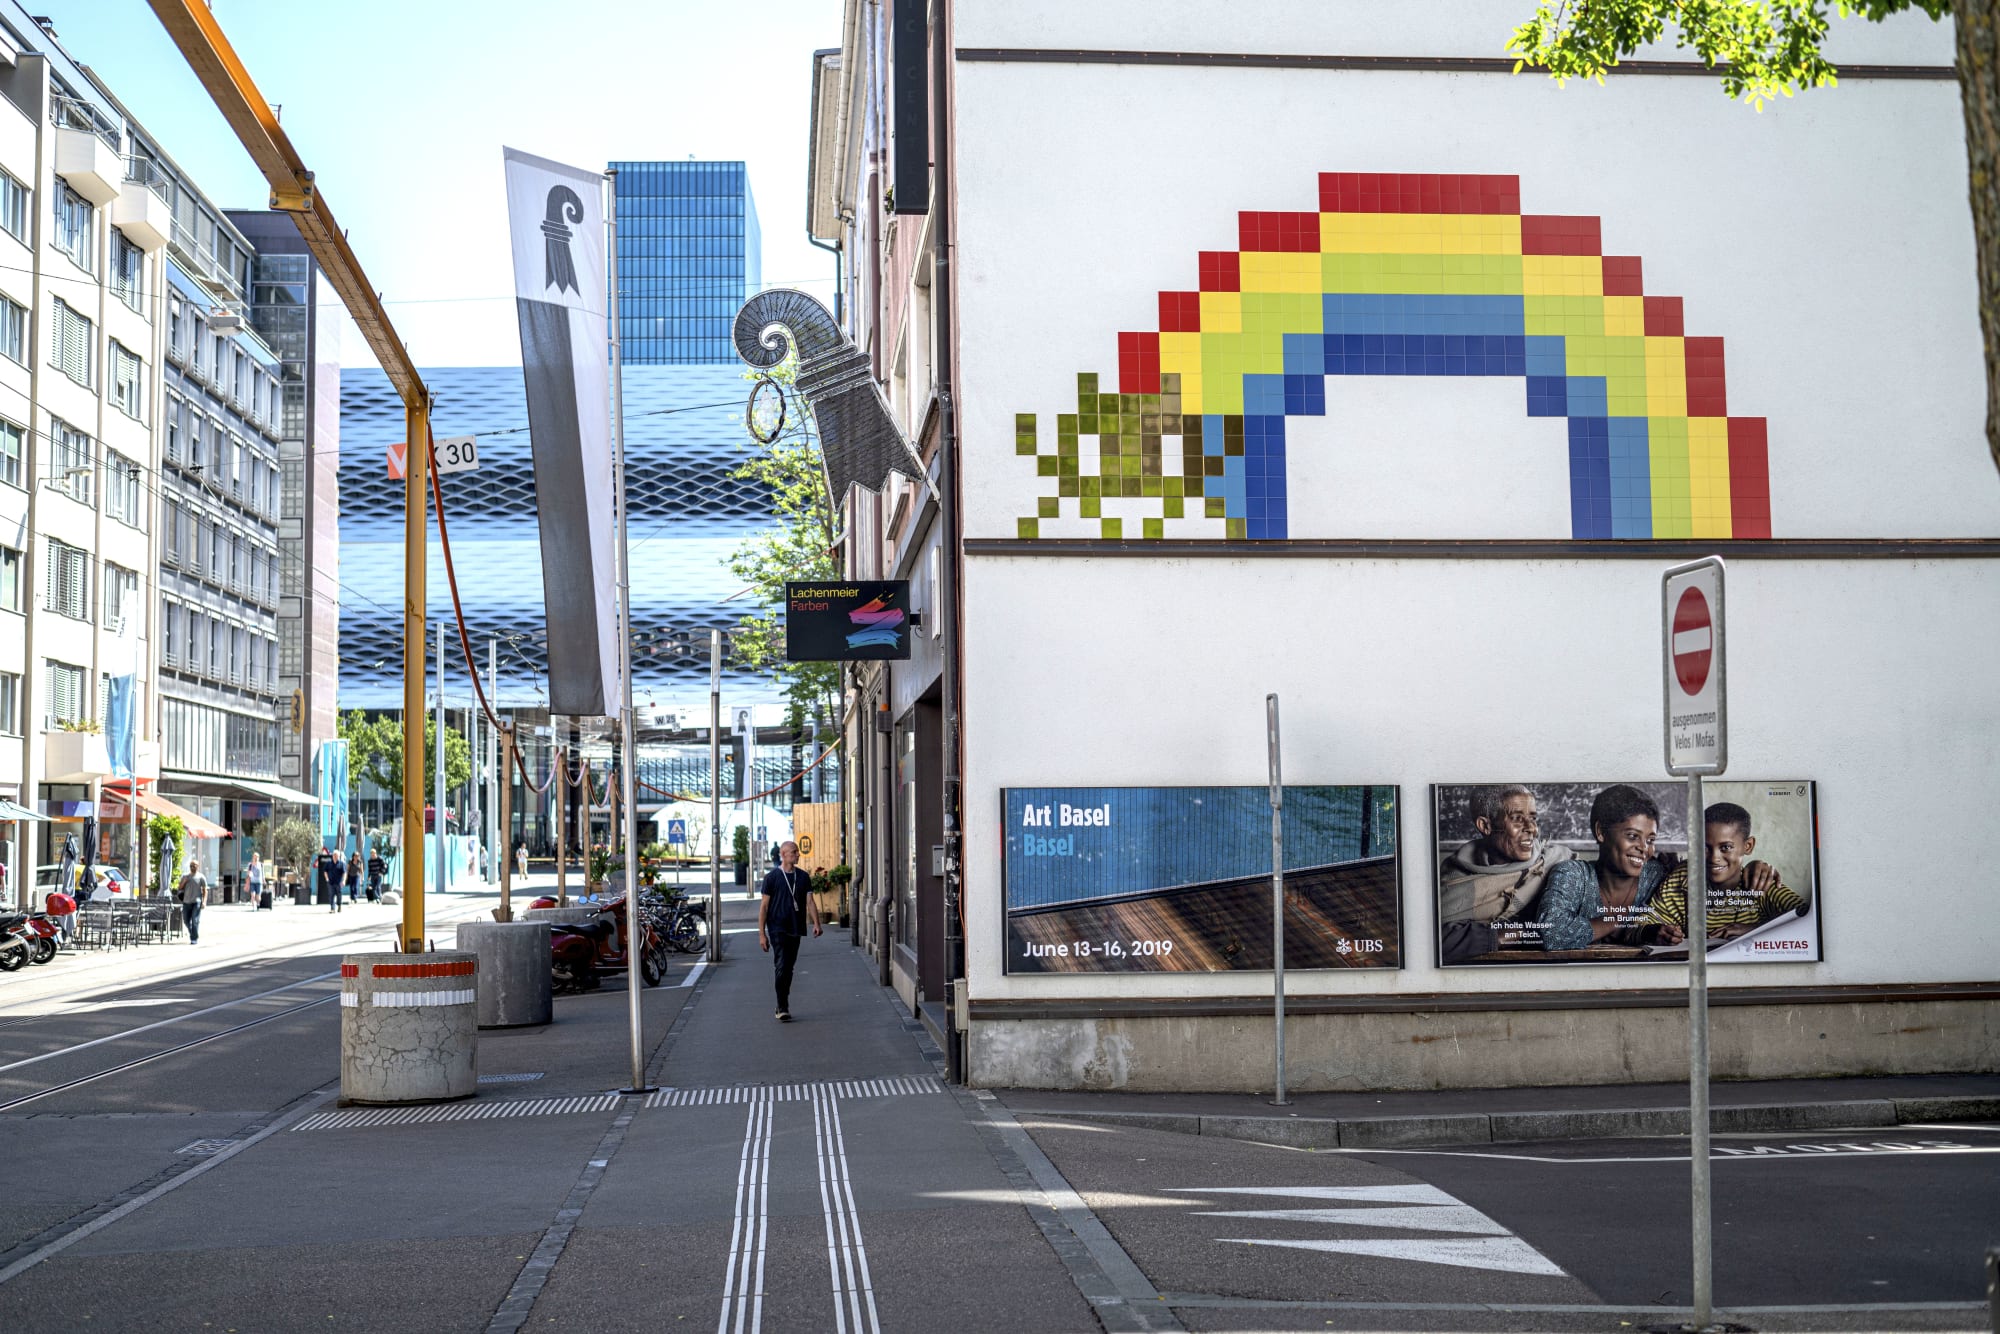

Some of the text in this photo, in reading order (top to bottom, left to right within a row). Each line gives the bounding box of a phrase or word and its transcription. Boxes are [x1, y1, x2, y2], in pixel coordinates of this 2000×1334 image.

[790, 587, 860, 598] Lachenmeier
[791, 601, 829, 611] Farben
[1672, 711, 1716, 731] ausgenommen
[1674, 733, 1692, 749] Velos
[1695, 731, 1715, 748] Mofas
[1023, 804, 1110, 826] Art Basel
[1024, 834, 1074, 856] Basel
[1707, 889, 1724, 897] hole
[1726, 889, 1764, 897] Bestnoten
[1714, 898, 1726, 906] der
[1727, 898, 1755, 906] Schule.
[1518, 930, 1541, 938] Teich.
[1023, 941, 1068, 957] June
[1131, 940, 1173, 956] 2019
[1354, 939, 1383, 952] UBS
[1754, 941, 1809, 950] HELVETAS
[1712, 1141, 1972, 1155] MOTOS
